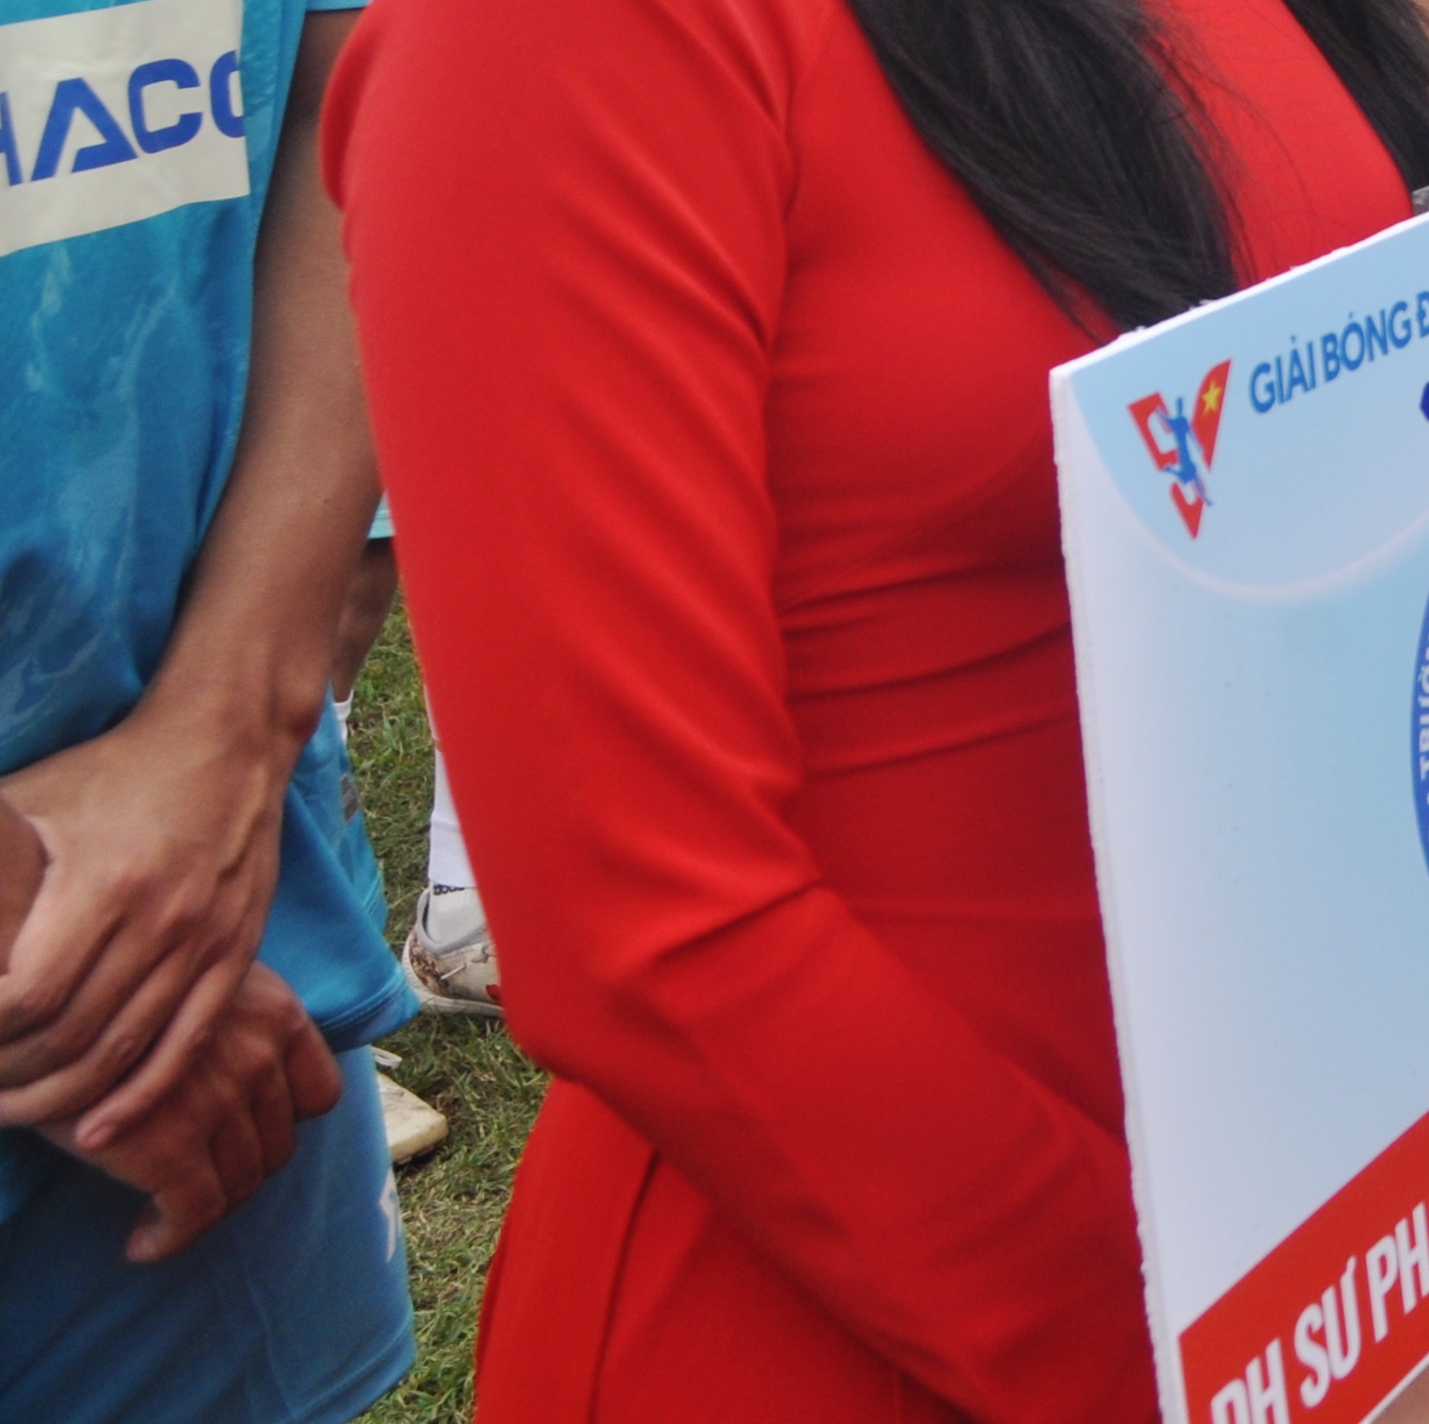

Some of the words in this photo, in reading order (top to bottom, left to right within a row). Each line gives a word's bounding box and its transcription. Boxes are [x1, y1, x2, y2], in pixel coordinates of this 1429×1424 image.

[1250, 335, 1317, 415] GIẢI
[1321, 300, 1412, 382] BÓNG
[1292, 1254, 1361, 1408] SƯ
